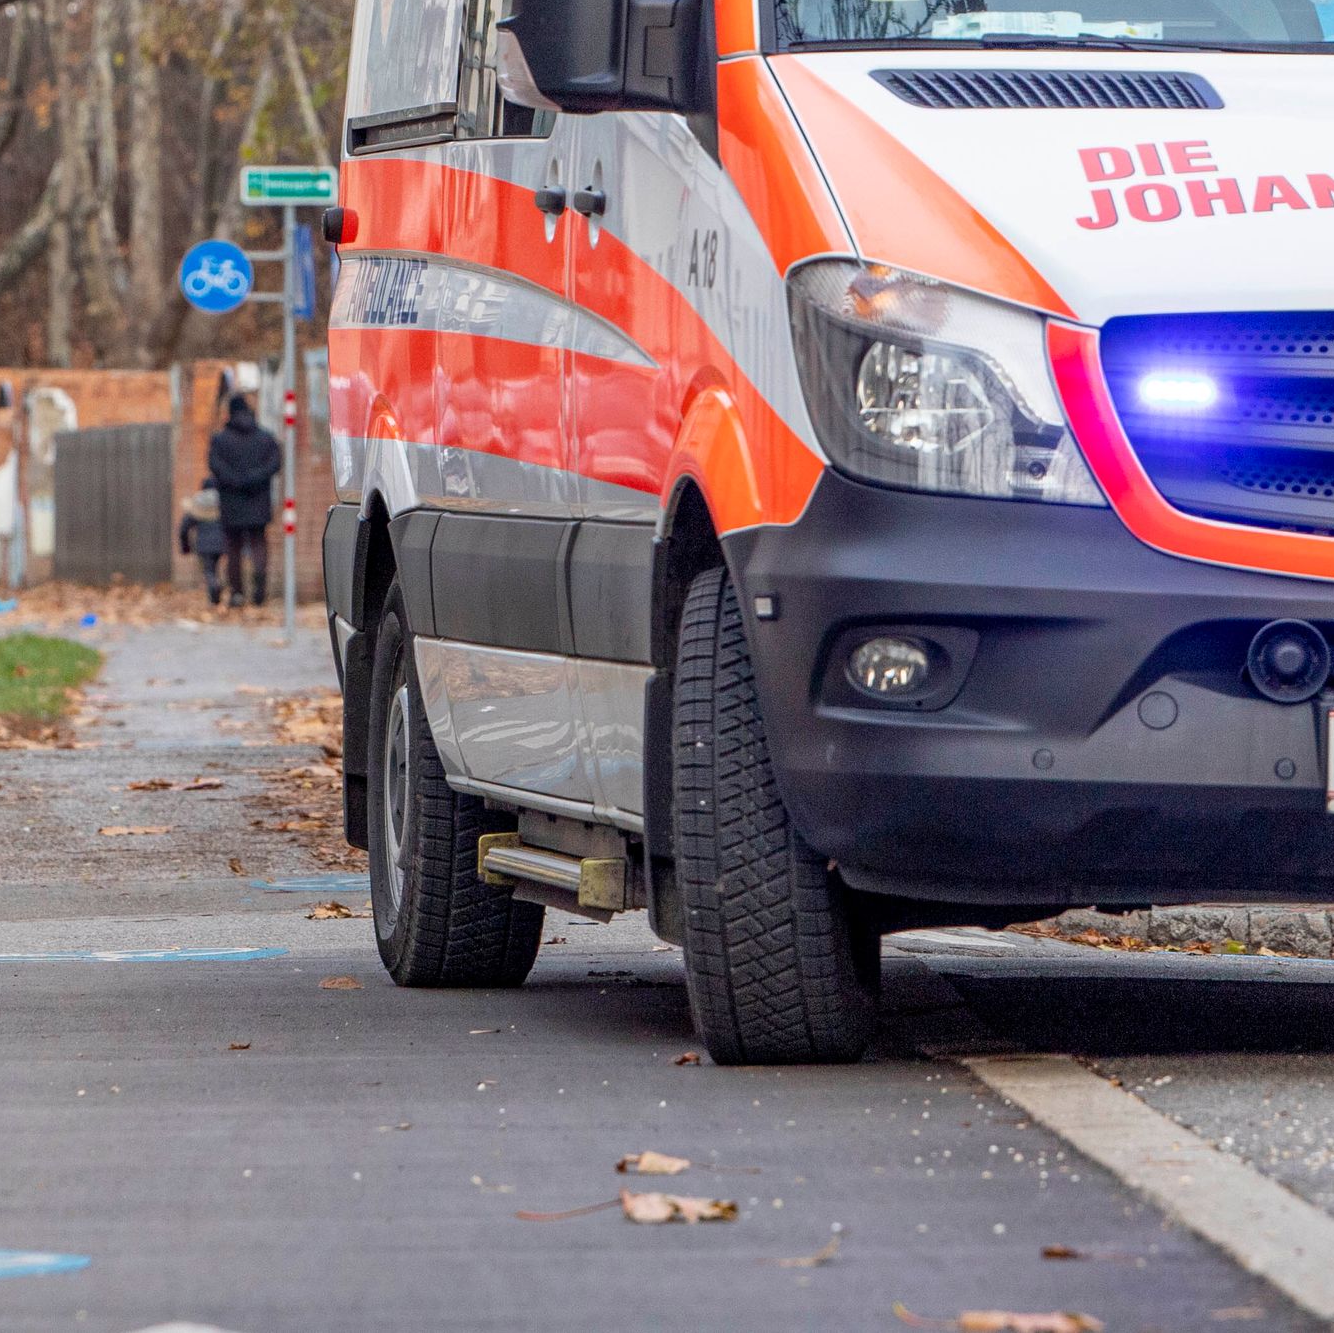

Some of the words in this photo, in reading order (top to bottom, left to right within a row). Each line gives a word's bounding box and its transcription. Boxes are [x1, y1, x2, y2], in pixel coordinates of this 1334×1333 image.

[1075, 140, 1220, 184] DIE
[687, 228, 699, 287] A
[702, 228, 719, 290] 18
[346, 256, 428, 325] AMBULANCE
